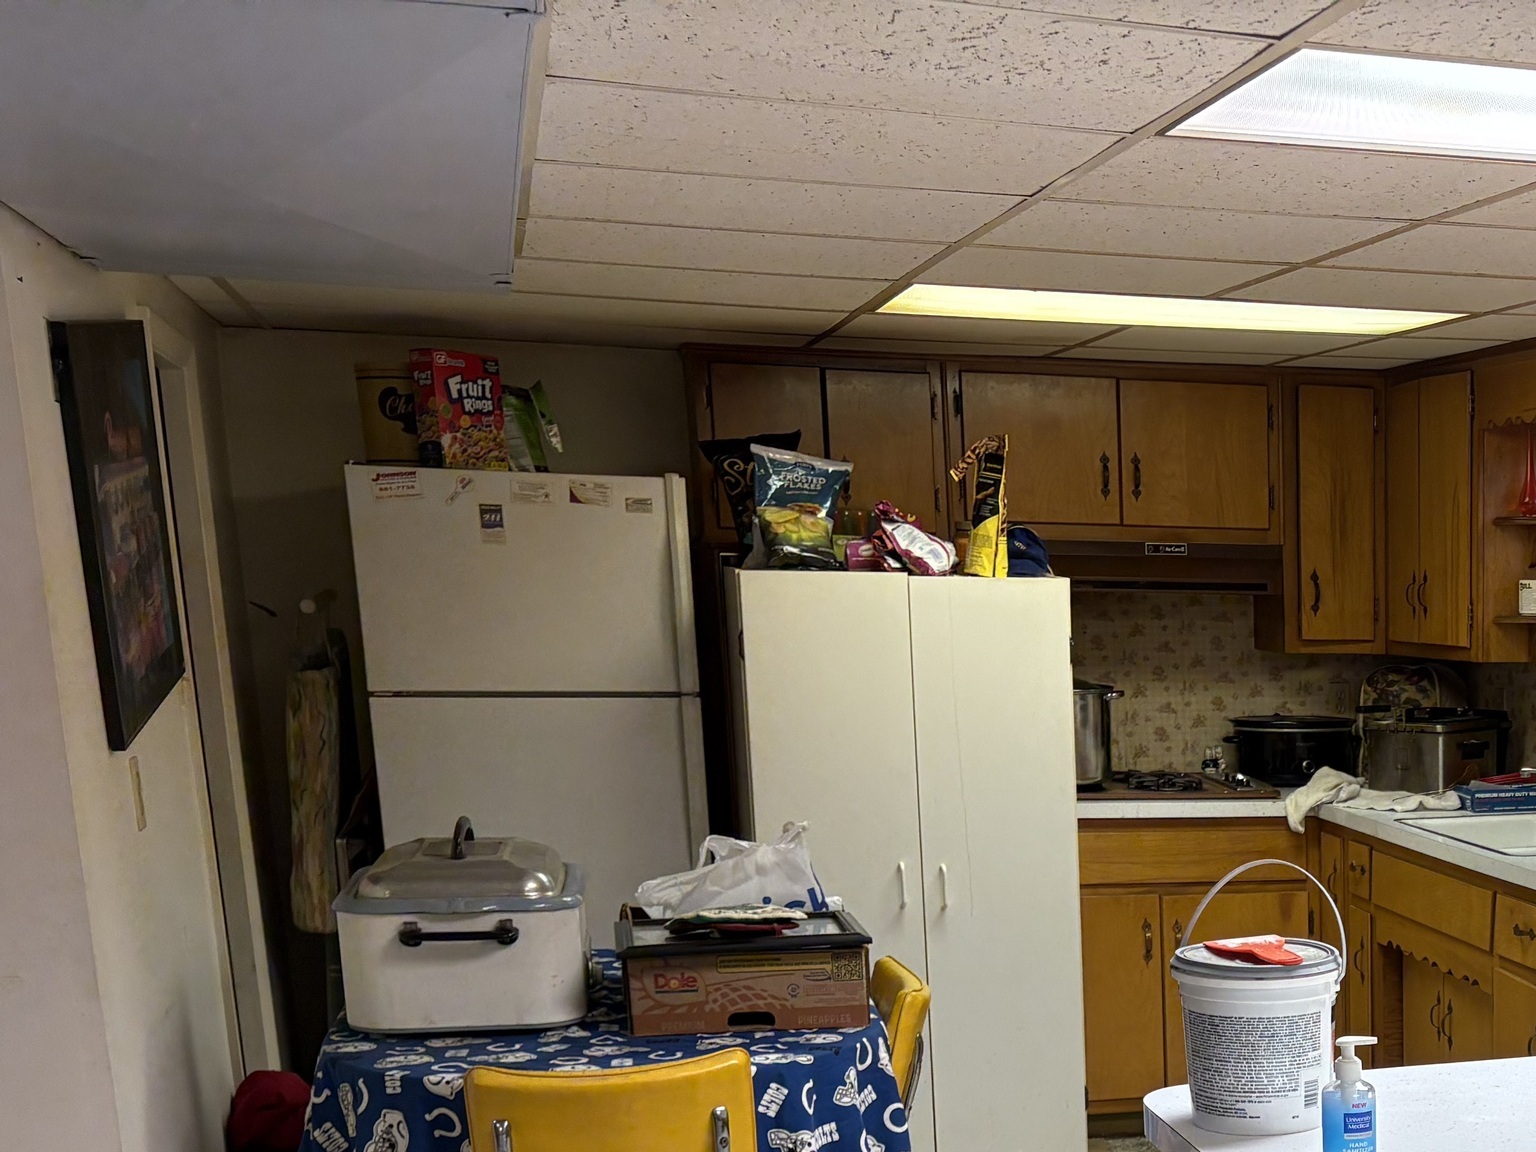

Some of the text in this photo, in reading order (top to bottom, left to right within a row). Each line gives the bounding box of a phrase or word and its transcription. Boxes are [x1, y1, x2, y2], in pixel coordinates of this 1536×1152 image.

[447, 374, 492, 400] Fruit
[464, 398, 493, 413] Rings
[654, 972, 698, 989] Dole
[798, 1014, 852, 1025] PINEAPPLES
[758, 1082, 789, 1119] COLTS
